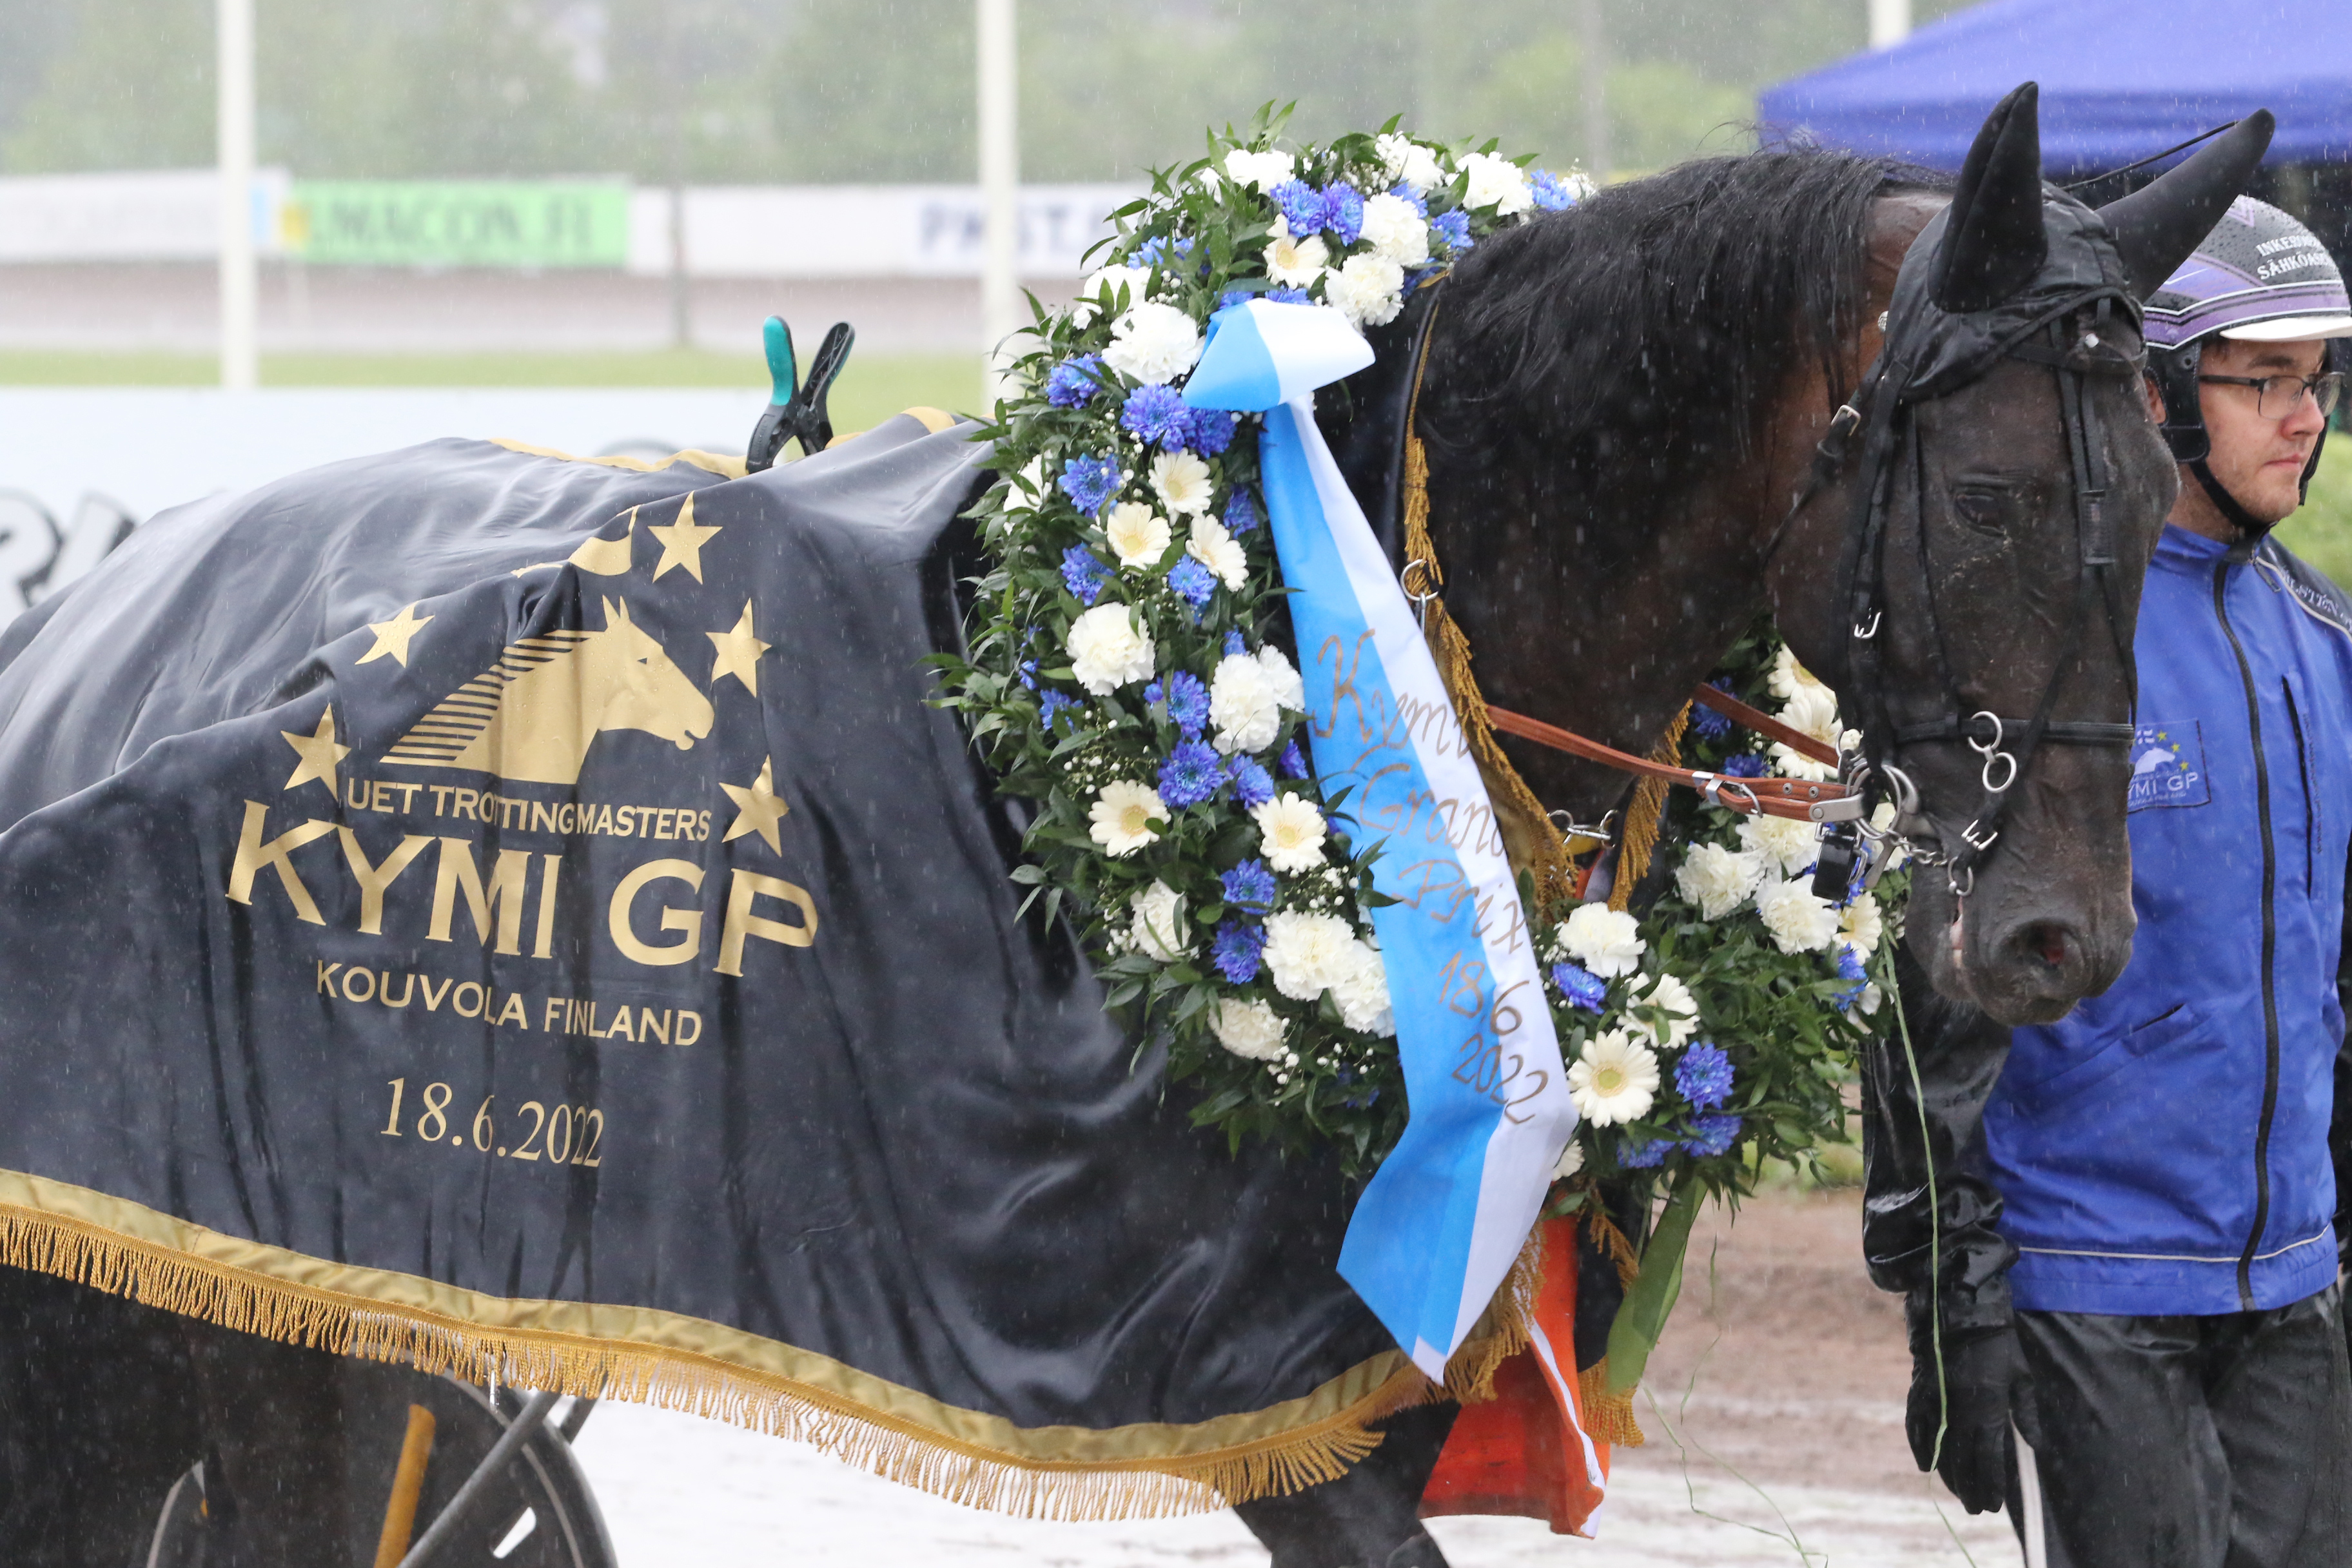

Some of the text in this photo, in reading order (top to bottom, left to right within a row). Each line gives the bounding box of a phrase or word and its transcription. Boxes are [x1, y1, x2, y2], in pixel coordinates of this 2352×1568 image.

[347, 777, 423, 814] UET
[2167, 772, 2198, 792] GP
[224, 799, 819, 977] KYMI GP
[1391, 859, 1526, 954] Prix
[317, 959, 703, 1046] KOUVOLA FINLAND
[380, 1077, 605, 1168] 18.6.2022
[1451, 1032, 1549, 1124] 2022
